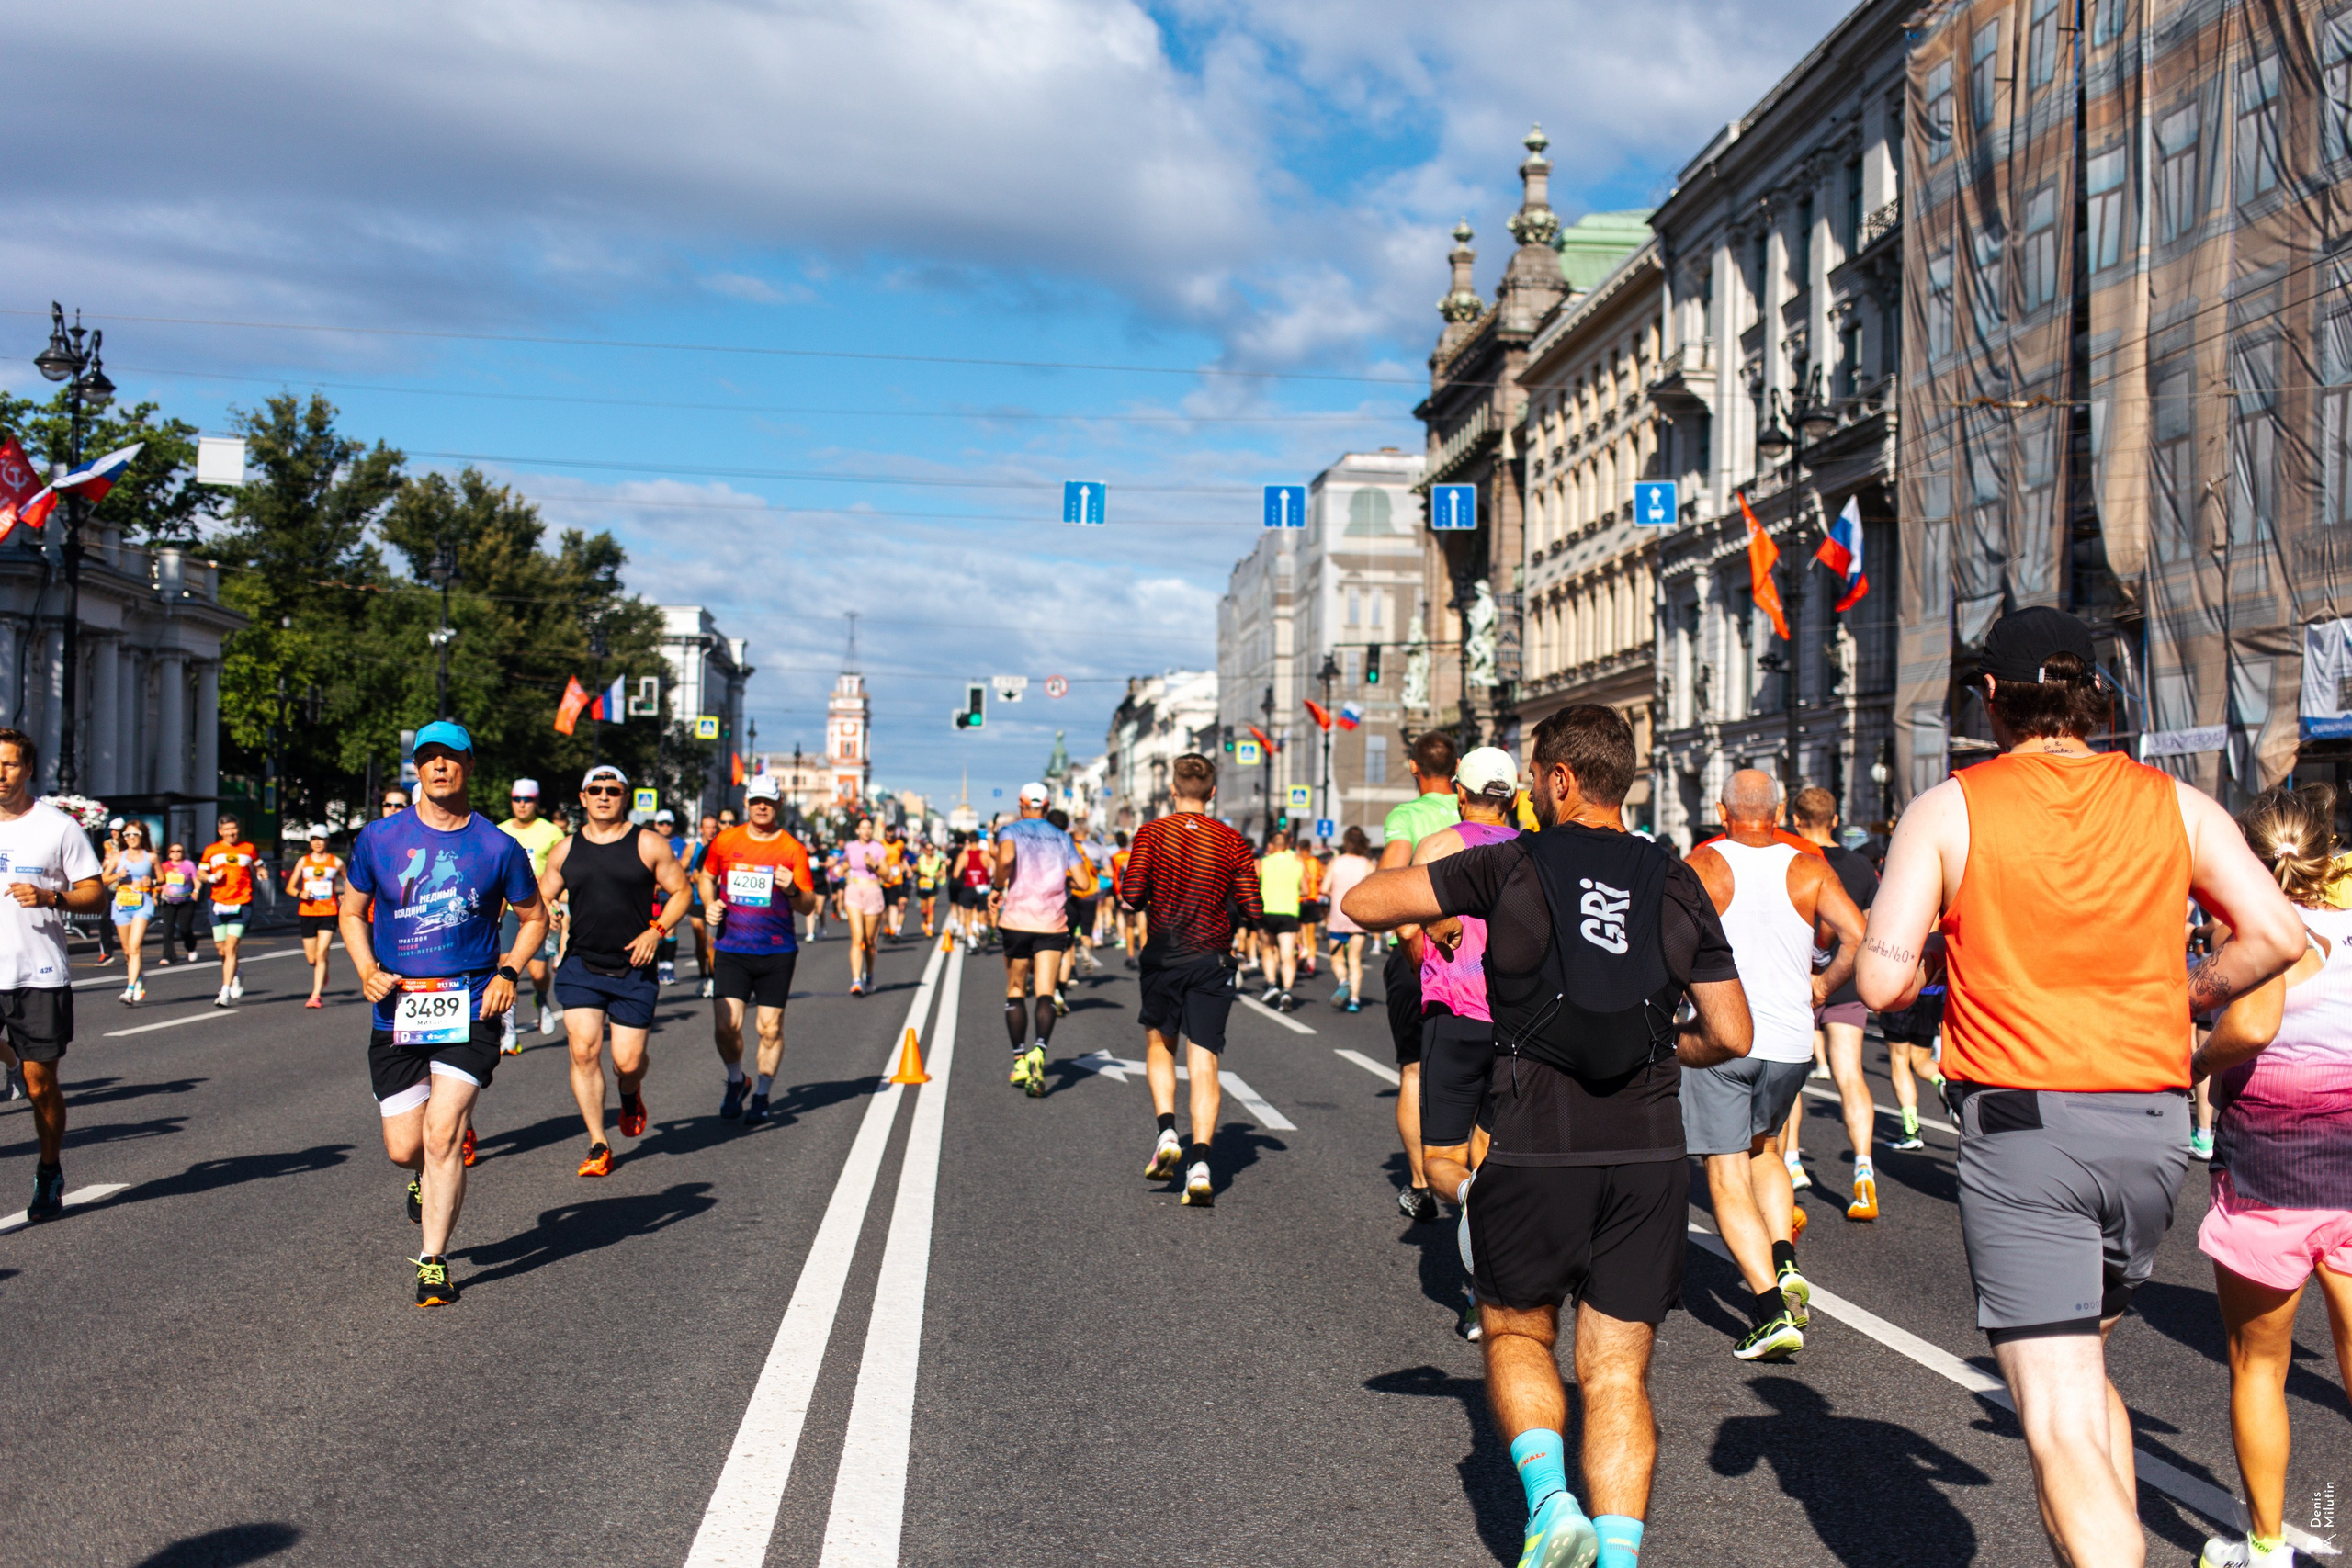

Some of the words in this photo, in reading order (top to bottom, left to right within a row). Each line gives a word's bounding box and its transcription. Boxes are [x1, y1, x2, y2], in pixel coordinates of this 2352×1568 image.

[733, 876, 766, 889] 4208
[419, 886, 458, 905] МЕДНЫЙ
[398, 935, 428, 944] ТРИАТЛОН
[405, 997, 460, 1018] 3489
[401, 1032, 411, 1043] D
[1523, 1452, 1546, 1465] HALF
